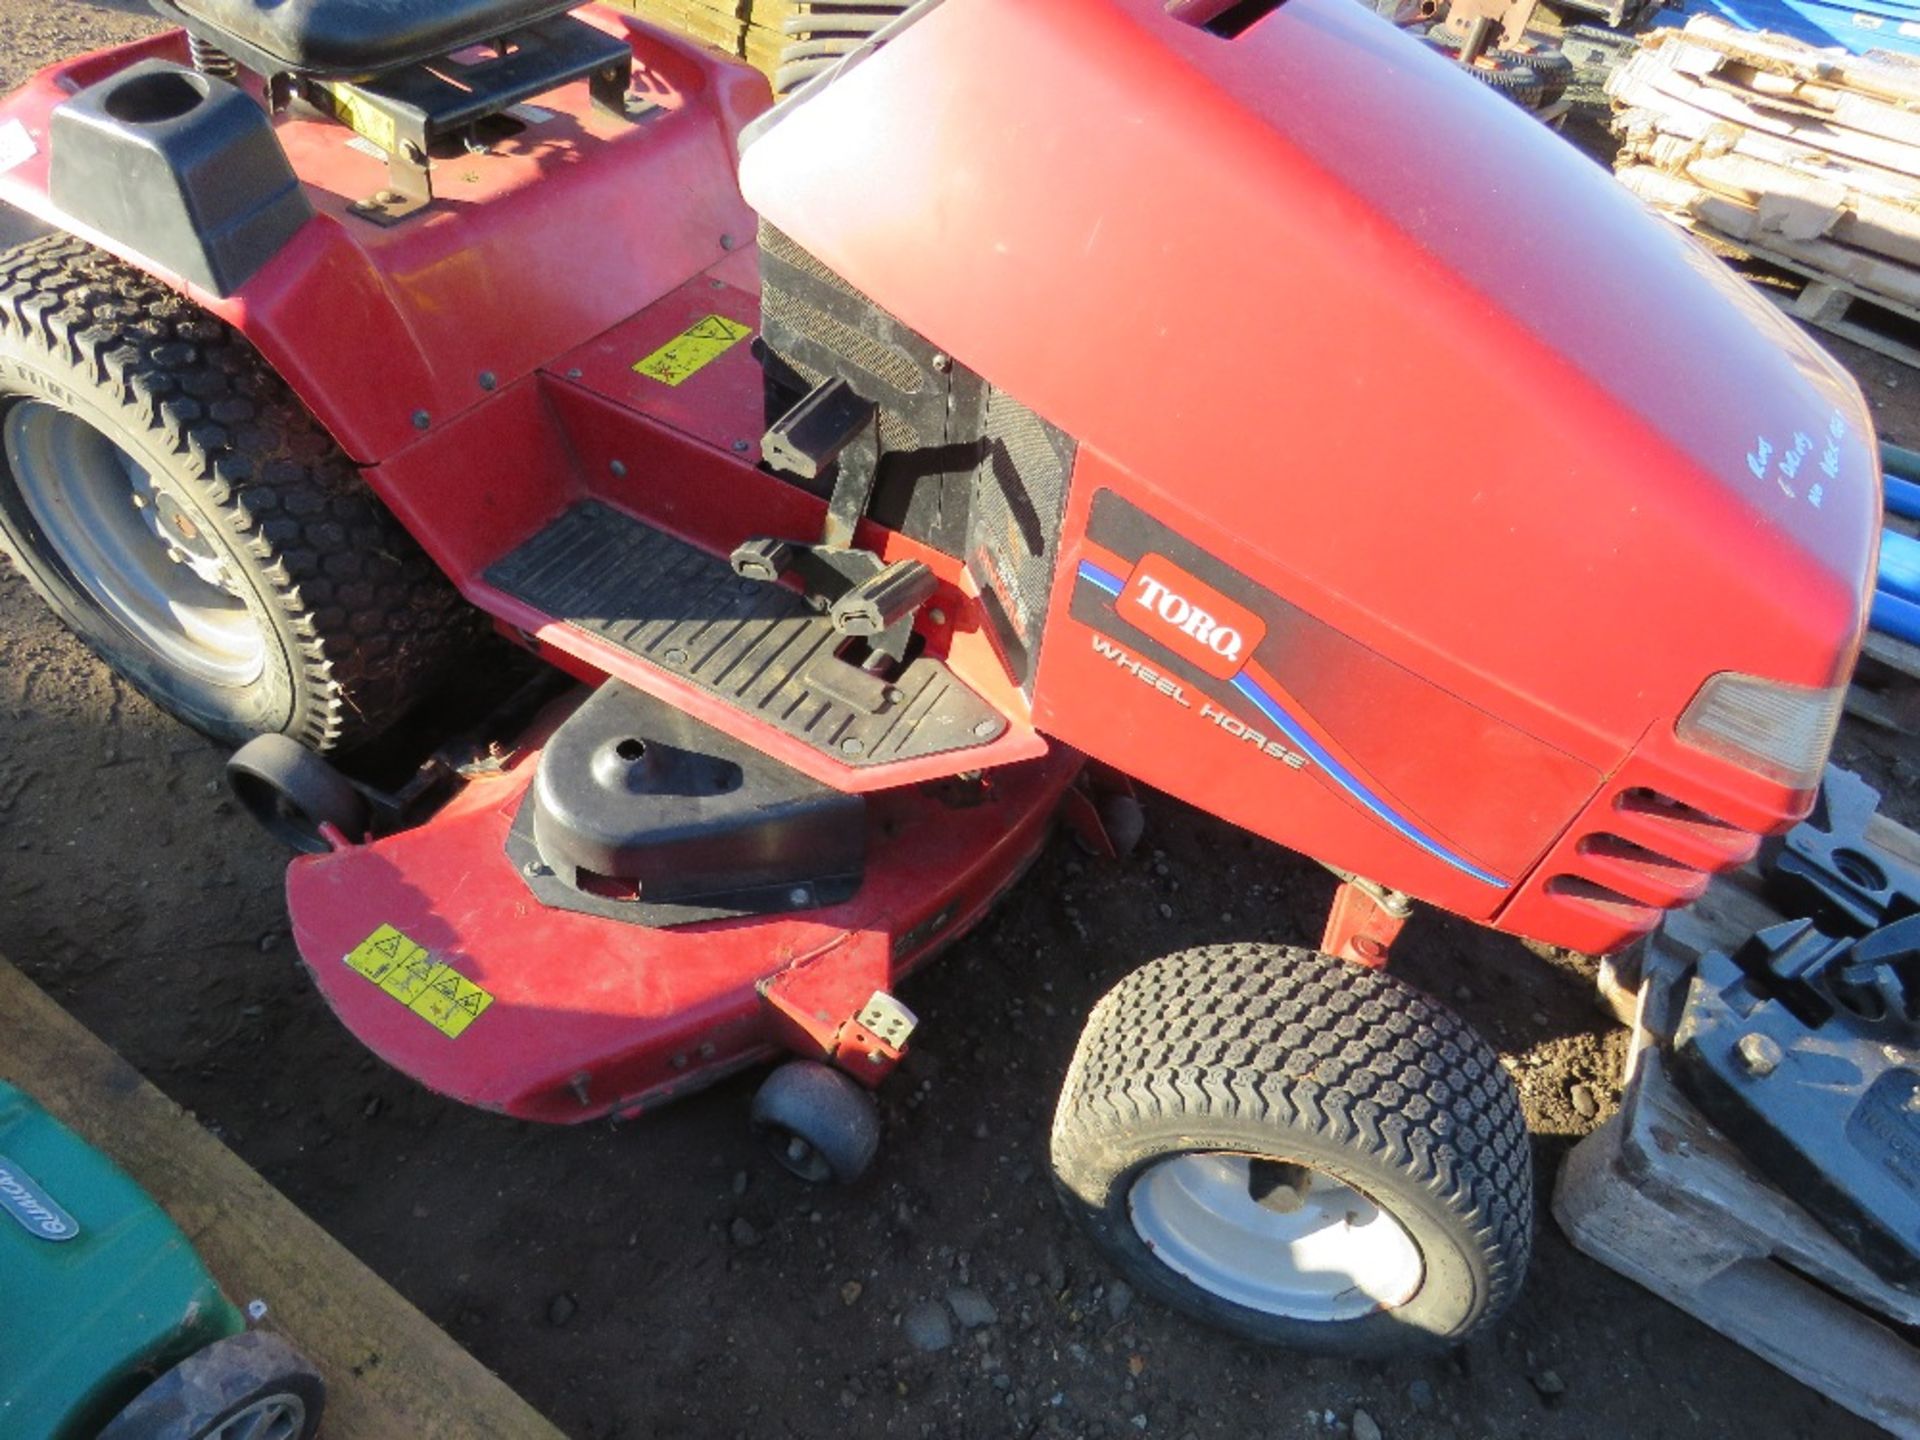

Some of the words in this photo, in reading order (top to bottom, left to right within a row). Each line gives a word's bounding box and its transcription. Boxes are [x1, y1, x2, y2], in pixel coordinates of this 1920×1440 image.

[1136, 575, 1242, 662] TORO
[1092, 633, 1191, 709] WHEEL
[1200, 704, 1308, 770] HORSE
